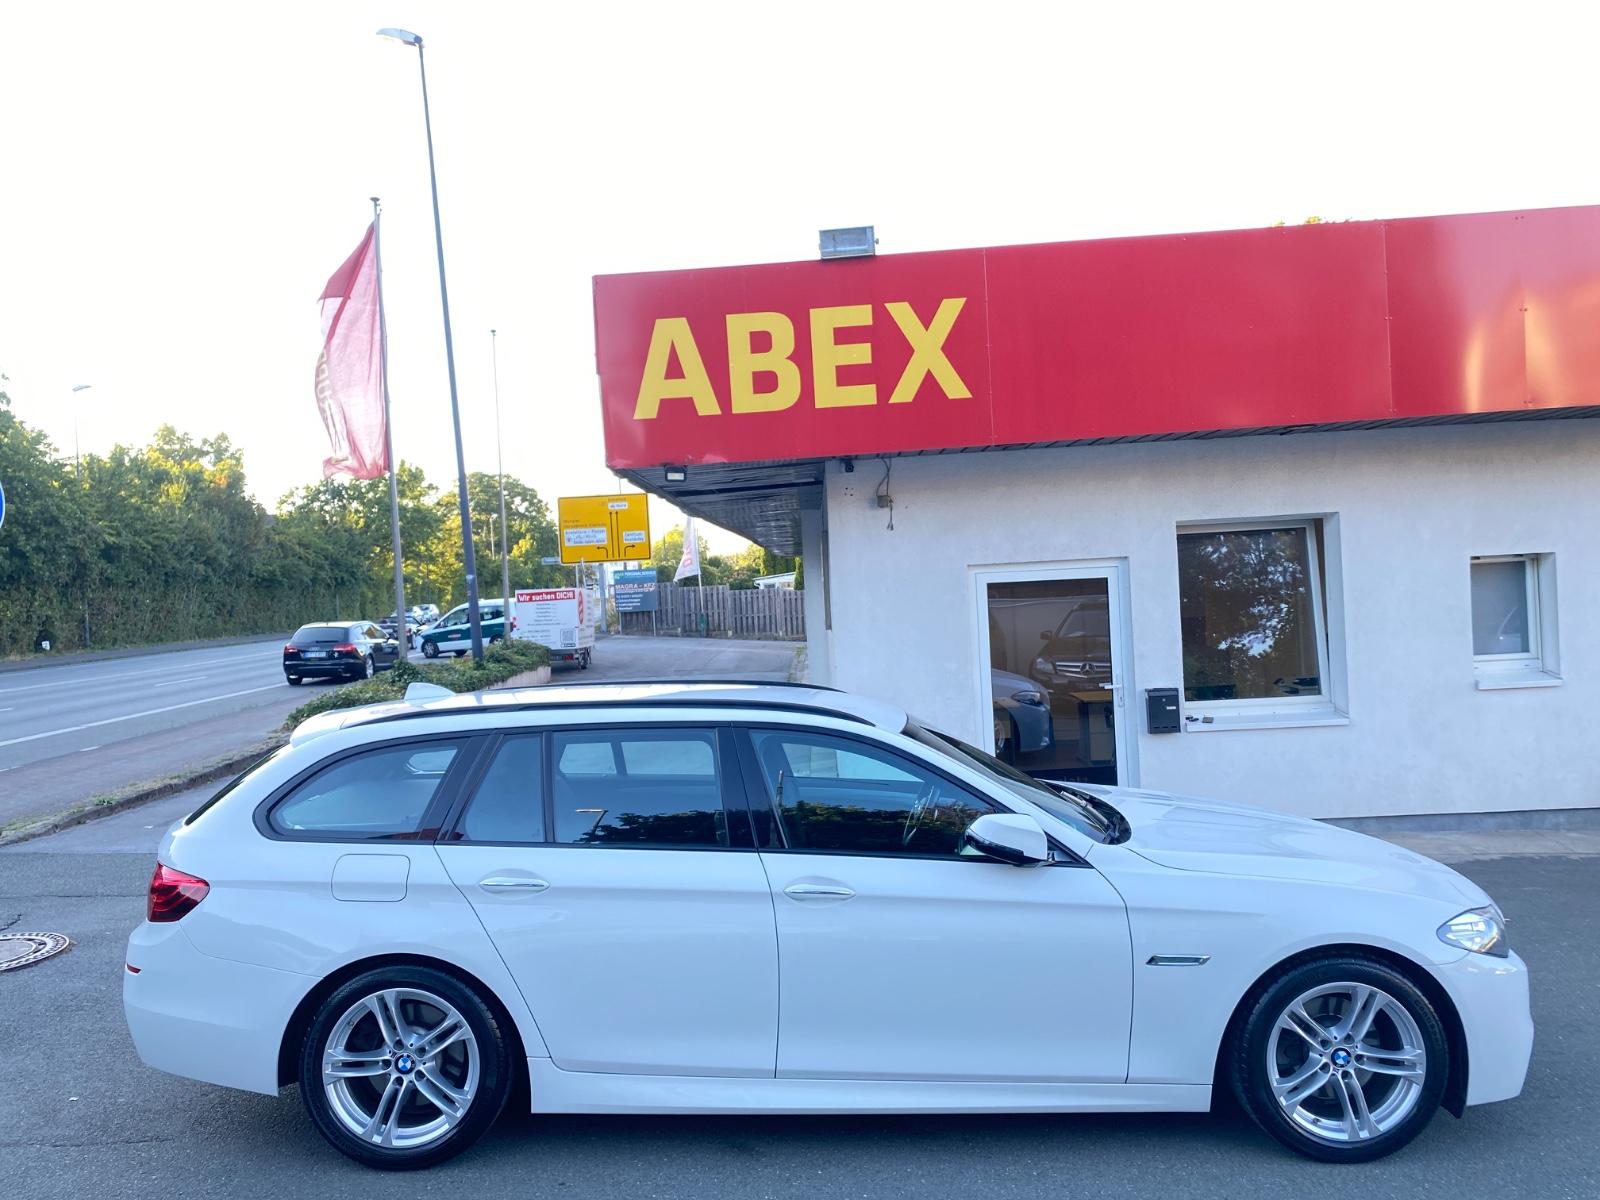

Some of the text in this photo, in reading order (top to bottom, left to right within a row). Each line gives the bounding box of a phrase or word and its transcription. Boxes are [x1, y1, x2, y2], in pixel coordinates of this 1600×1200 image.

[633, 297, 973, 420] ABEX
[518, 592, 574, 602] Wir suchen DICH!
